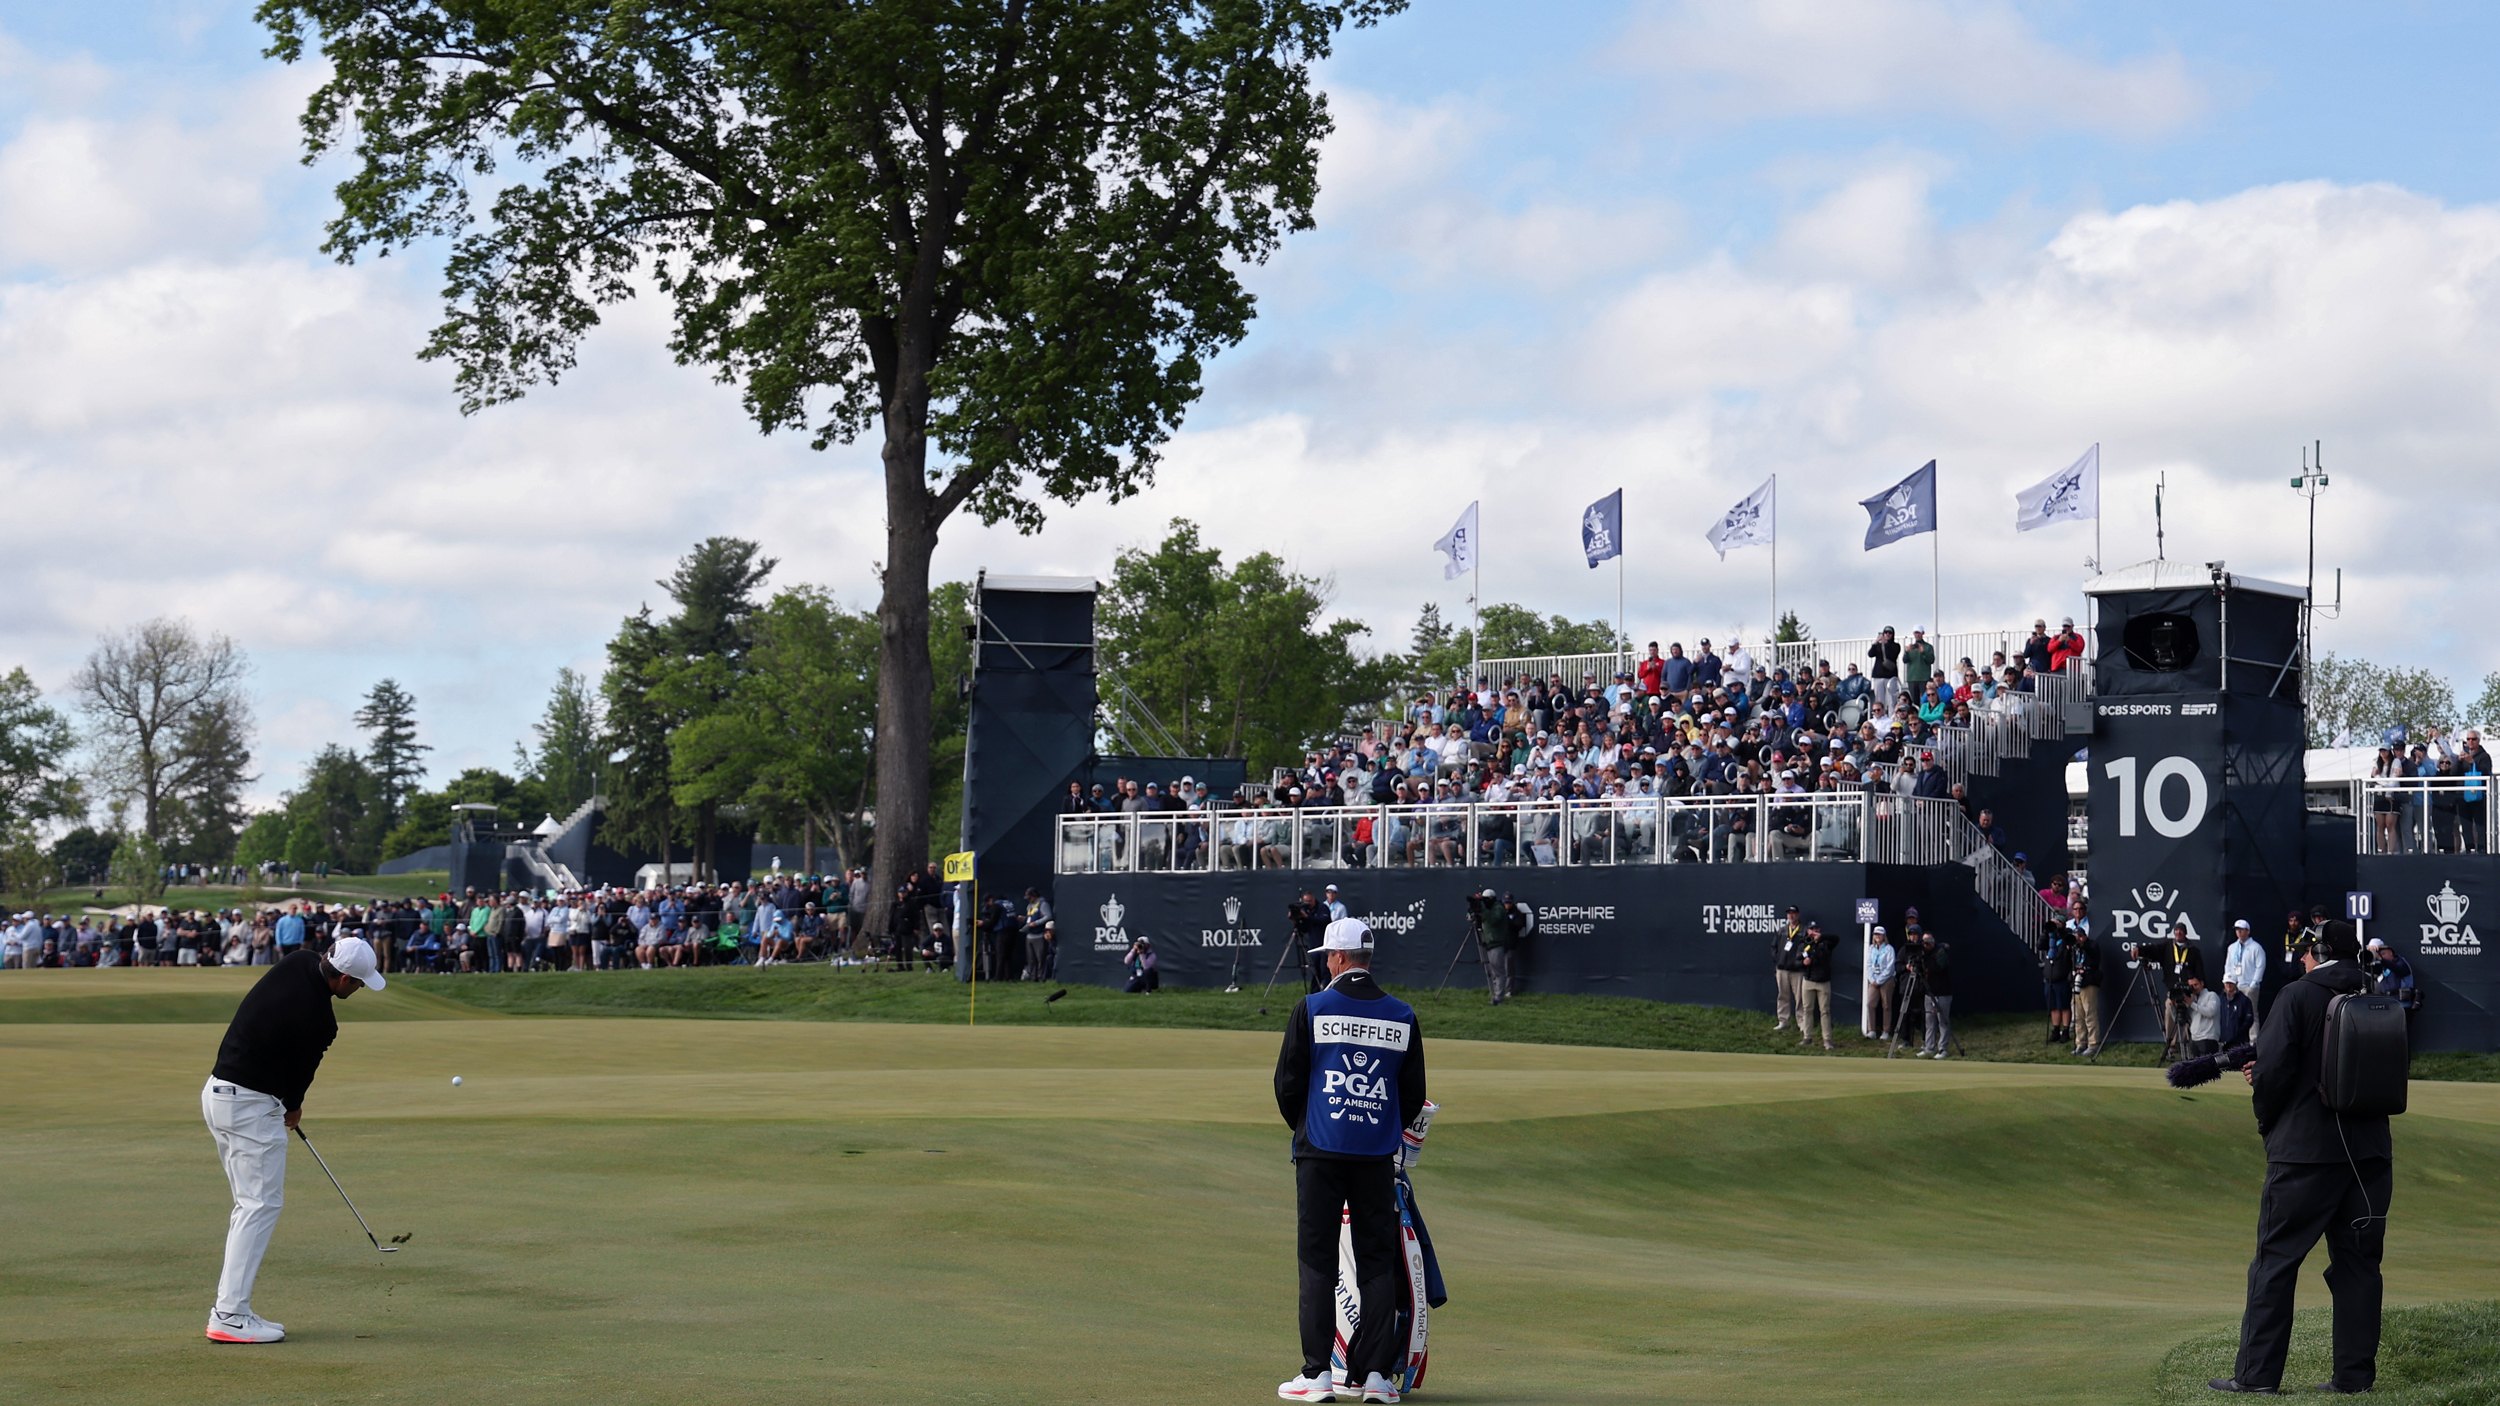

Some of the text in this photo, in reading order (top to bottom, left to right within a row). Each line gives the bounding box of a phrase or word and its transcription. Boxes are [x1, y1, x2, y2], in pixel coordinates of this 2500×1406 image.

[2107, 704, 2172, 715] CBS SPORTS
[2181, 703, 2217, 715] ESPN
[2105, 755, 2208, 838] 10
[1538, 906, 1615, 920] SAPPHIRE
[1724, 904, 1775, 919] T-MOBILE
[1858, 906, 1876, 914] PGA
[2349, 895, 2369, 916] 10
[1724, 919, 1790, 933] FOR BUSINE
[2112, 909, 2201, 940] PGA
[1094, 926, 1129, 943] PGA
[1201, 929, 1262, 947] ROLEX
[2419, 923, 2481, 945] PGA
[2420, 946, 2482, 956] CHAMPIONSHIP
[1322, 1022, 1402, 1044] SCHEFFLER
[1322, 1069, 1389, 1101] PGA
[1328, 1096, 1382, 1111] OF AMERICA
[1348, 1113, 1364, 1123] 1916
[1414, 1269, 1426, 1340] Taylor Made
